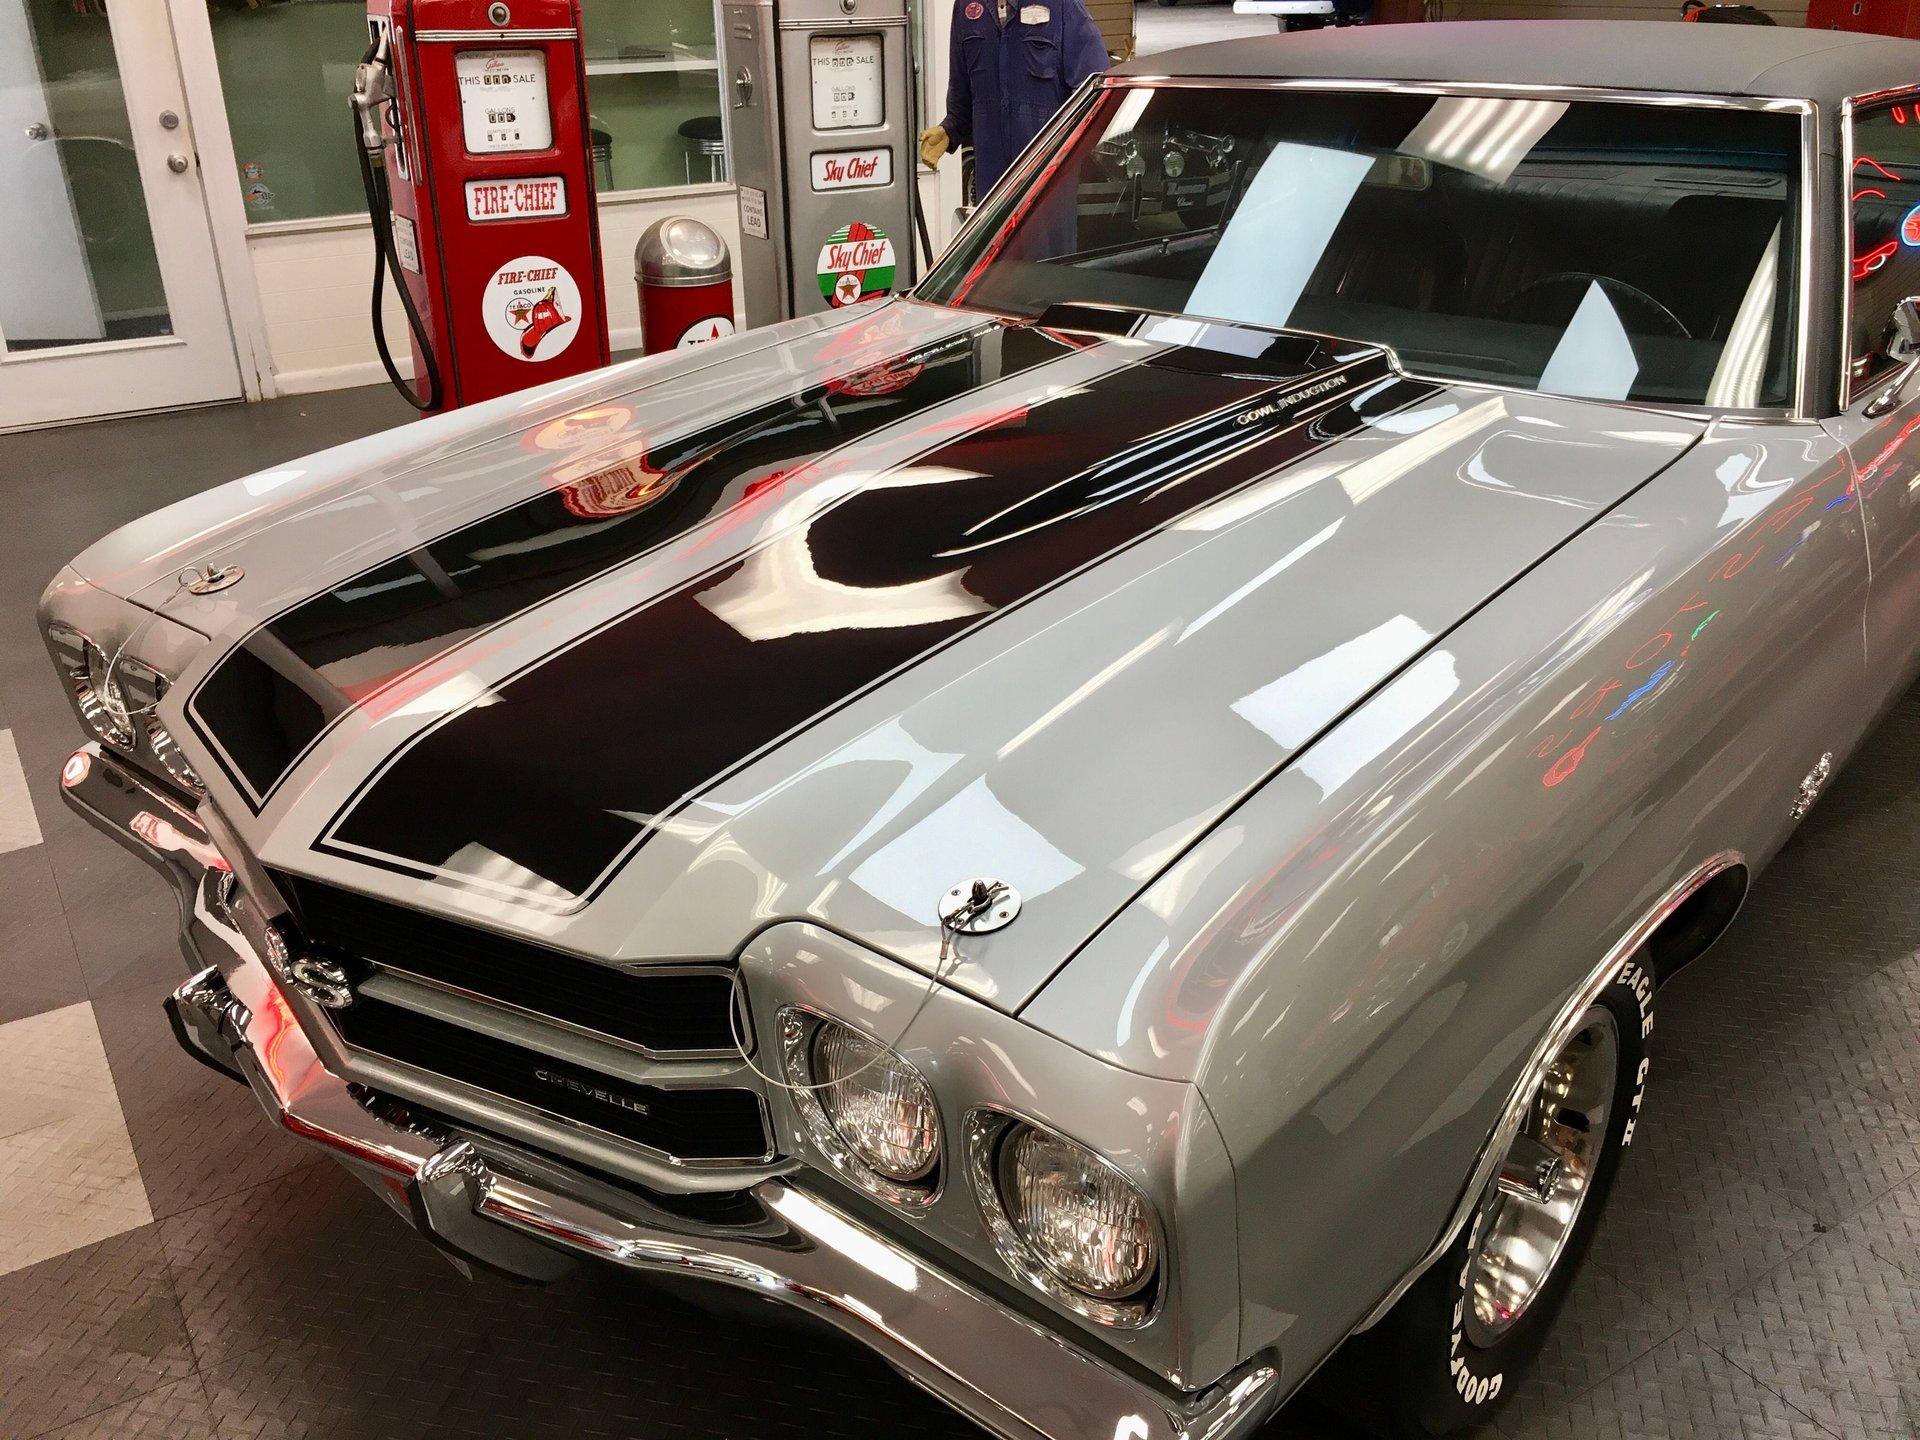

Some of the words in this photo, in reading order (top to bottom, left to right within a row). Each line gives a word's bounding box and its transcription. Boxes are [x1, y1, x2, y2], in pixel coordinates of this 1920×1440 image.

[813, 58, 830, 66] THIS
[856, 56, 874, 64] SALE
[458, 76, 480, 86] THIS
[513, 74, 536, 83] SALE
[823, 159, 844, 182] Sky
[847, 156, 878, 179] Chief
[473, 182, 558, 216] FIRE-CHIEF
[827, 244, 852, 270] Sky
[853, 241, 886, 266] Chief
[497, 267, 559, 285] FIRE-CHIEF
[513, 286, 546, 296] GASOLINE
[1236, 404, 1279, 426] COWL
[1278, 374, 1348, 411] INDUCTION
[1616, 962, 1654, 1039] EAGLE
[535, 1069, 648, 1115] CHEVELLE
[1632, 1057, 1649, 1113] GT
